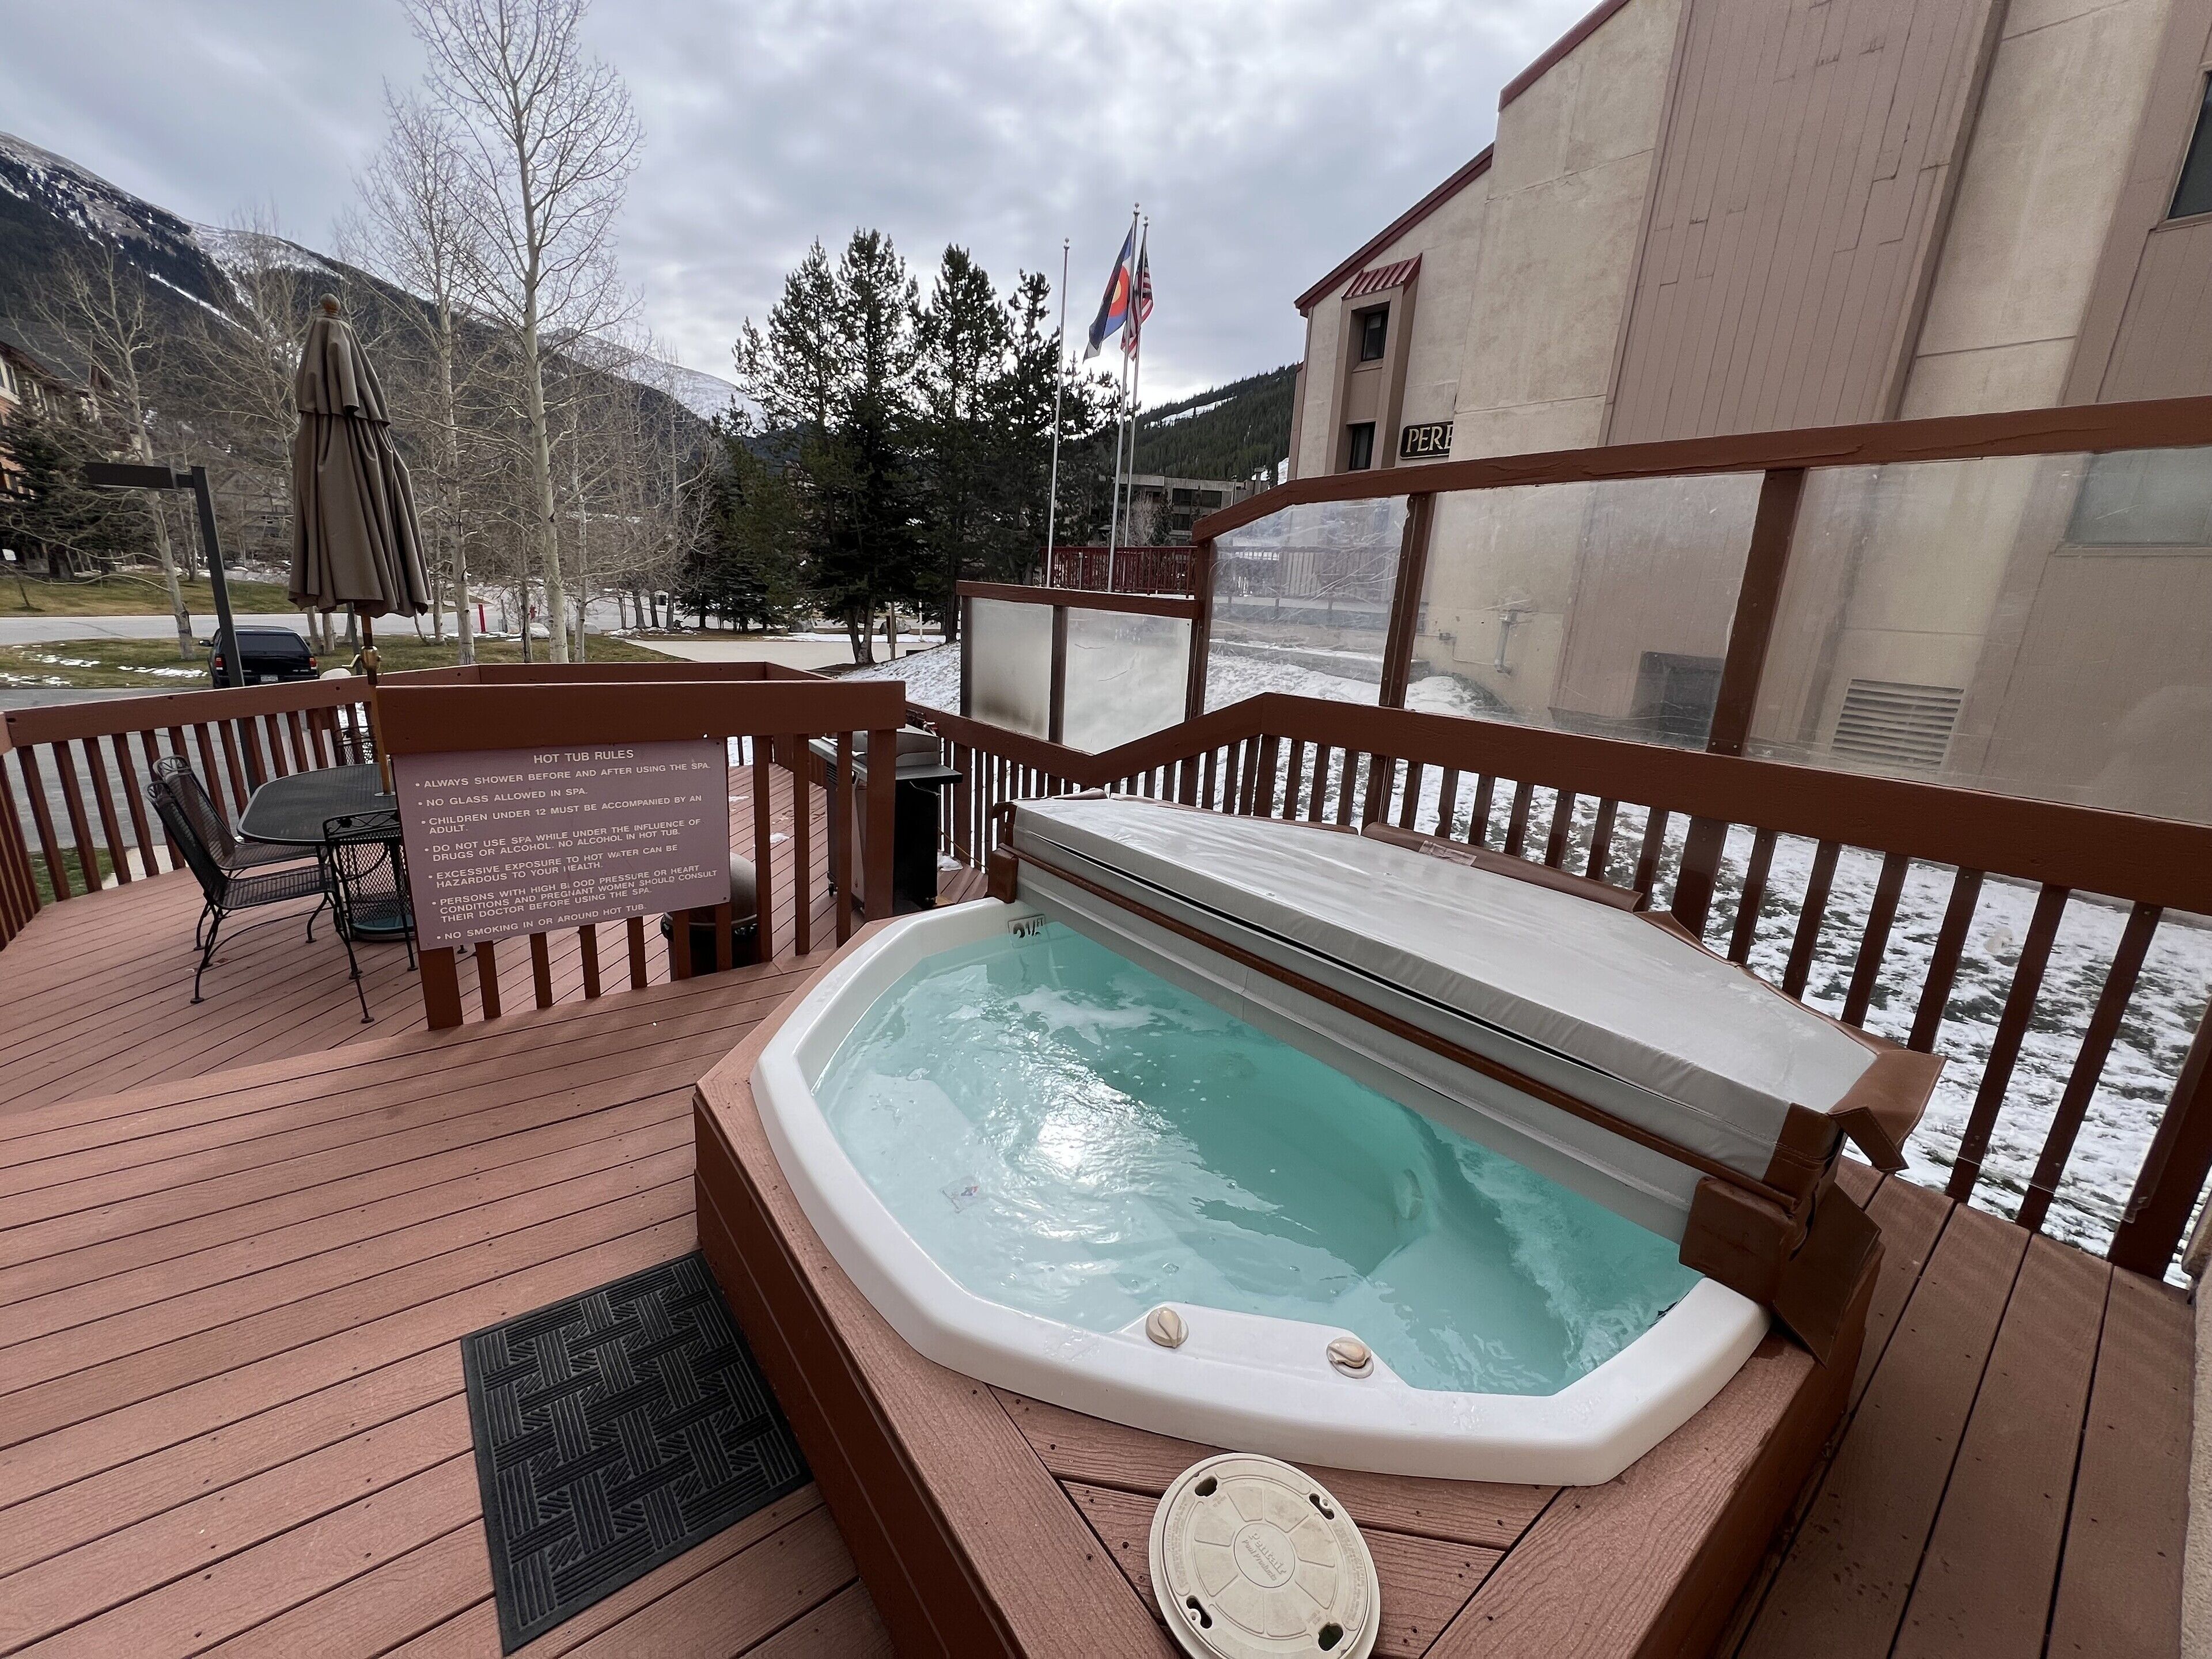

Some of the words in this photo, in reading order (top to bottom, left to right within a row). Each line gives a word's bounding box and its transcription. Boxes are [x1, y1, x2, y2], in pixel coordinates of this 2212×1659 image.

[533, 753, 560, 764] HOT
[564, 752, 590, 762] TUB
[594, 749, 634, 760] RULES
[424, 778, 469, 788] ALWAYS
[474, 774, 524, 785] SHOWER
[528, 771, 571, 781] BEFORE
[575, 769, 597, 778] AND
[601, 767, 632, 776] AFTER
[636, 764, 666, 774] USING
[426, 798, 444, 807] NO
[449, 794, 489, 805] GLASS
[494, 790, 546, 802] ALLOWED
[566, 787, 588, 796] SPA.
[429, 813, 488, 825] CHILDREN
[492, 809, 531, 820] UNDER
[550, 805, 580, 815] MUST
[584, 803, 597, 812] BE
[601, 797, 671, 810] ACCOMPANIED
[429, 824, 468, 835] ADULT.
[433, 844, 450, 853] DO
[455, 841, 478, 850] NOT
[483, 838, 506, 847] USE
[511, 836, 532, 844] SPA
[536, 831, 569, 842] WHILE
[572, 828, 608, 838] UNDER
[611, 825, 630, 834] THE
[634, 820, 684, 831] INFLUENCE
[433, 850, 474, 862] DRUGS
[479, 848, 495, 857] OR
[499, 842, 554, 854] ALCOHOL.
[558, 839, 573, 848] NO
[577, 834, 623, 846] ALCOHOL
[626, 832, 635, 840] IN
[639, 831, 658, 839] HOT
[660, 828, 680, 836] TUB.
[436, 865, 500, 880] EXCESSIVE
[505, 858, 562, 871] EXPOSURE
[565, 855, 579, 863] TO
[584, 853, 604, 862] HOT
[607, 849, 639, 859] WATER
[642, 846, 662, 855] CAN
[665, 844, 678, 852] BE
[436, 873, 507, 888] HAZARDOUS
[511, 870, 526, 878] TO
[530, 866, 559, 876] YOUR
[440, 892, 494, 906] PERSONS
[499, 888, 526, 897] WITH
[531, 884, 556, 893] HIGH
[599, 871, 650, 884] PRESSURE
[671, 865, 700, 874] HEART
[440, 899, 509, 914] CONDITIONS
[514, 895, 536, 904] AND
[540, 887, 594, 900] PREGNANT
[597, 882, 635, 892] WOMEN
[639, 876, 675, 887] SHOULD
[677, 870, 718, 881] CONSULT
[440, 913, 474, 923] THEIR
[478, 905, 524, 918] DOCTOR
[529, 898, 571, 910] BEFORE
[574, 893, 606, 904] USING
[609, 889, 628, 899] THE
[632, 887, 652, 895] SPA.
[444, 931, 461, 940] NO
[467, 923, 518, 937] SMOKING
[537, 918, 553, 926] OR
[557, 910, 599, 923] AROUND
[603, 907, 622, 916] HOT
[625, 903, 646, 912] TUB.
[1241, 1539, 1256, 1554] Pool
[1253, 1554, 1277, 1581] Products
